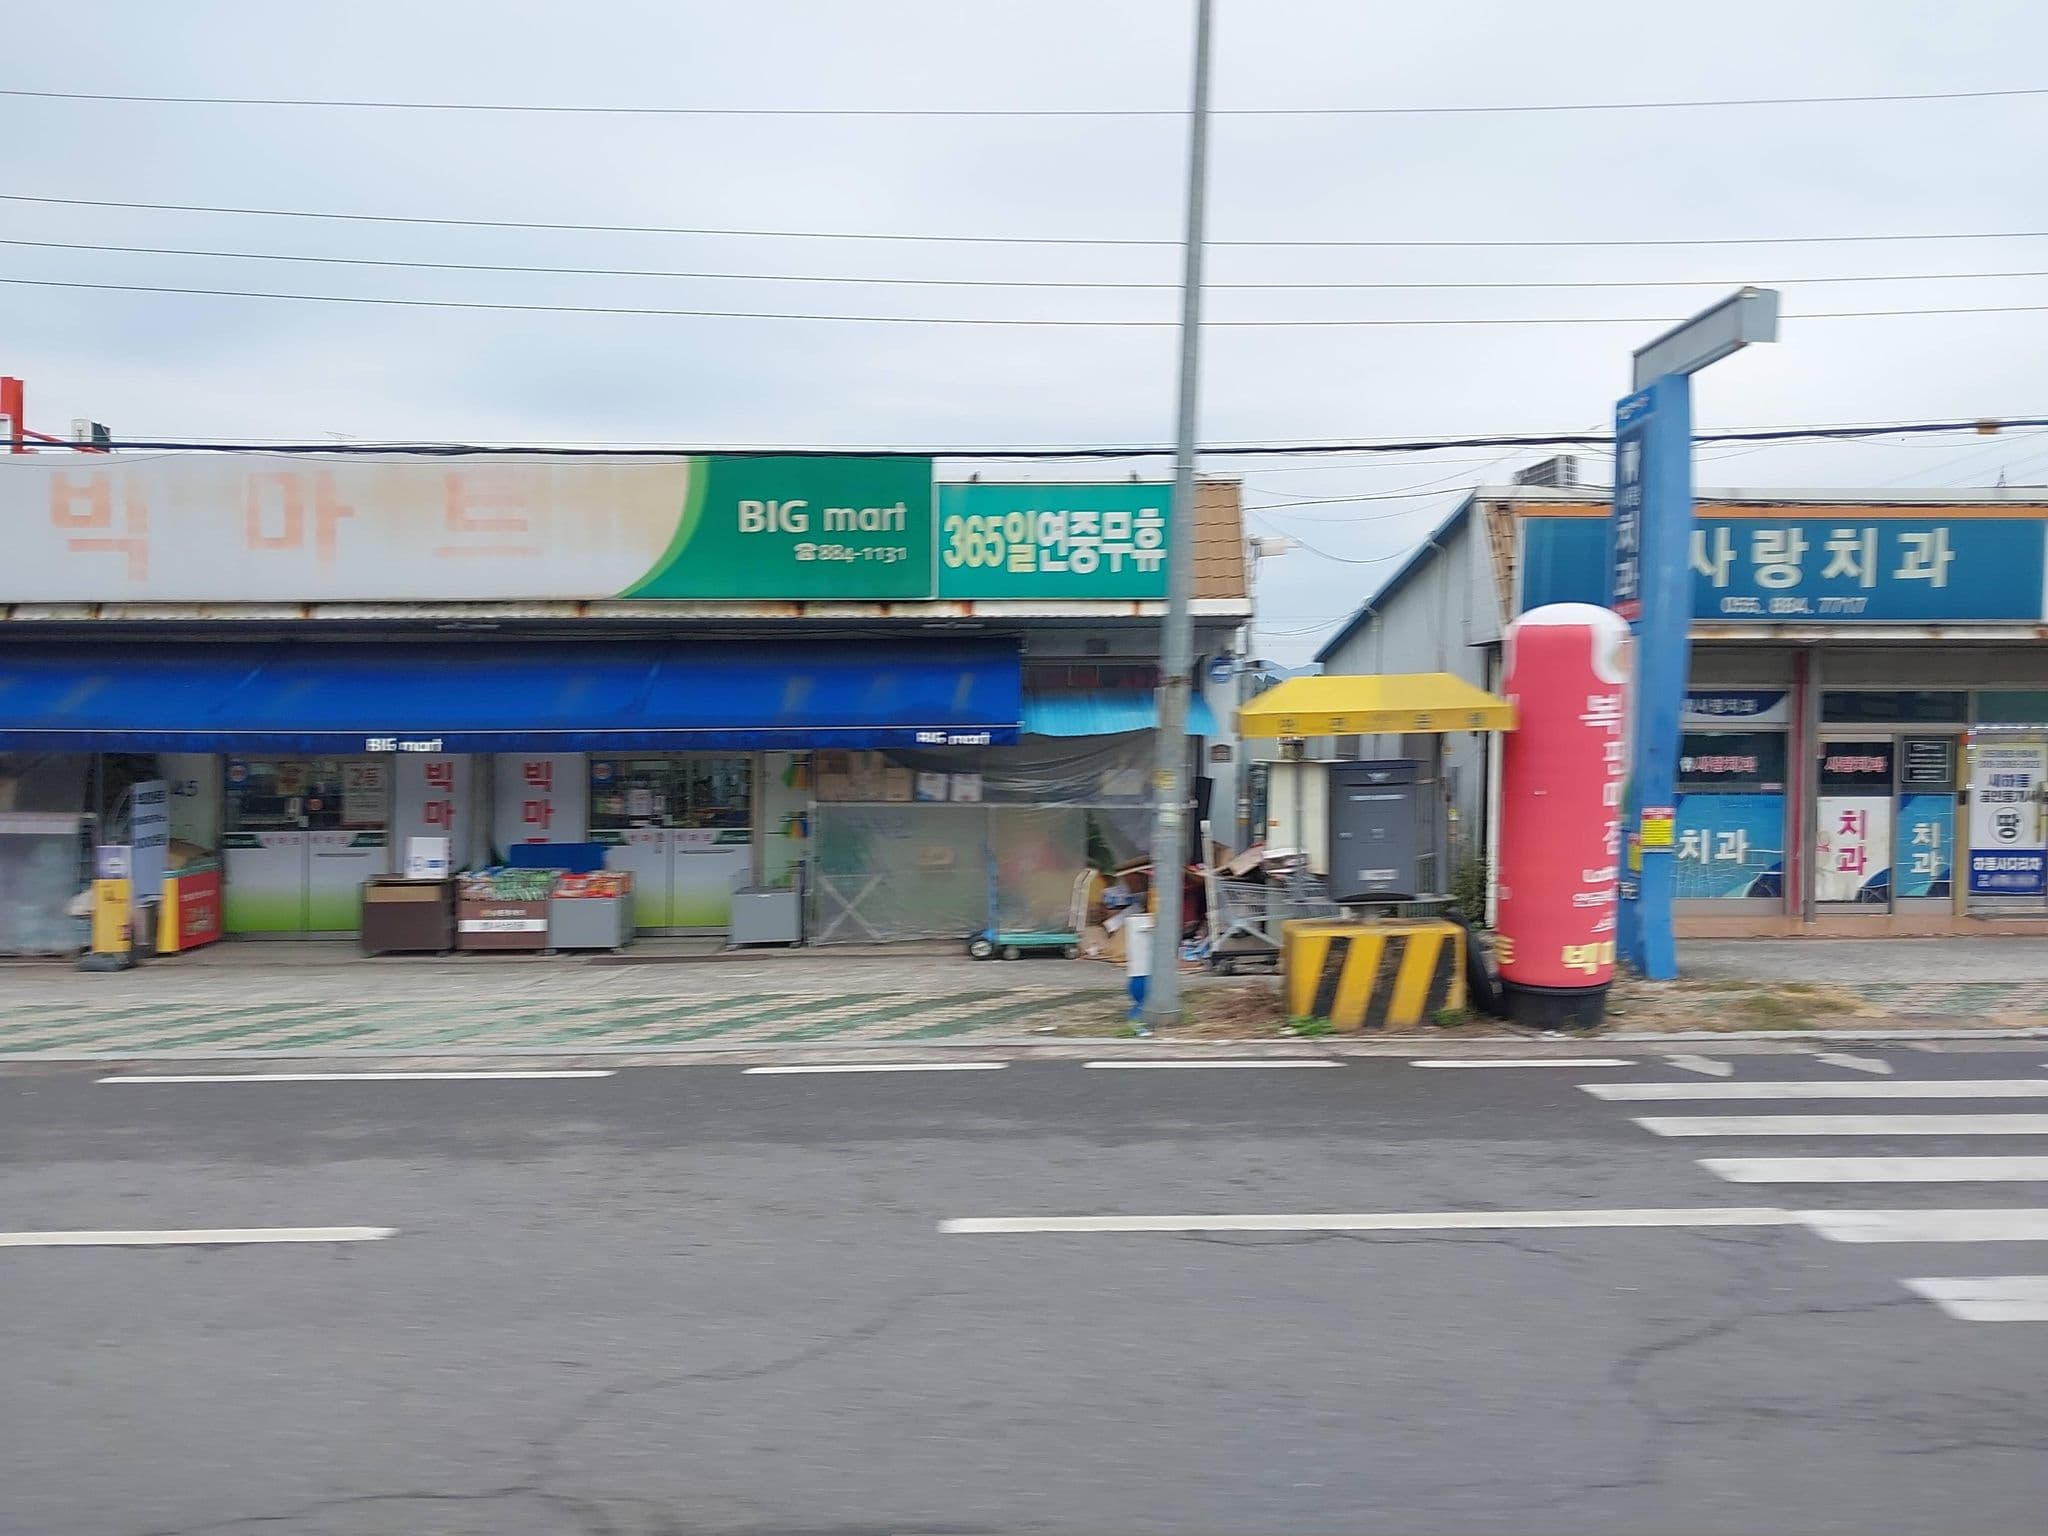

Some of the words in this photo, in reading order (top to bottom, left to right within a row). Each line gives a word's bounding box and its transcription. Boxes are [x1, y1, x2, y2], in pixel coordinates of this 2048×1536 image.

[737, 500, 809, 533] BIG
[822, 502, 907, 532] mart
[365, 738, 397, 752] BIG
[398, 738, 443, 752] mart
[948, 731, 991, 745] mart
[1678, 829, 1751, 865] 치과
[1837, 809, 1867, 876] 치과
[1911, 822, 1942, 878] 치과
